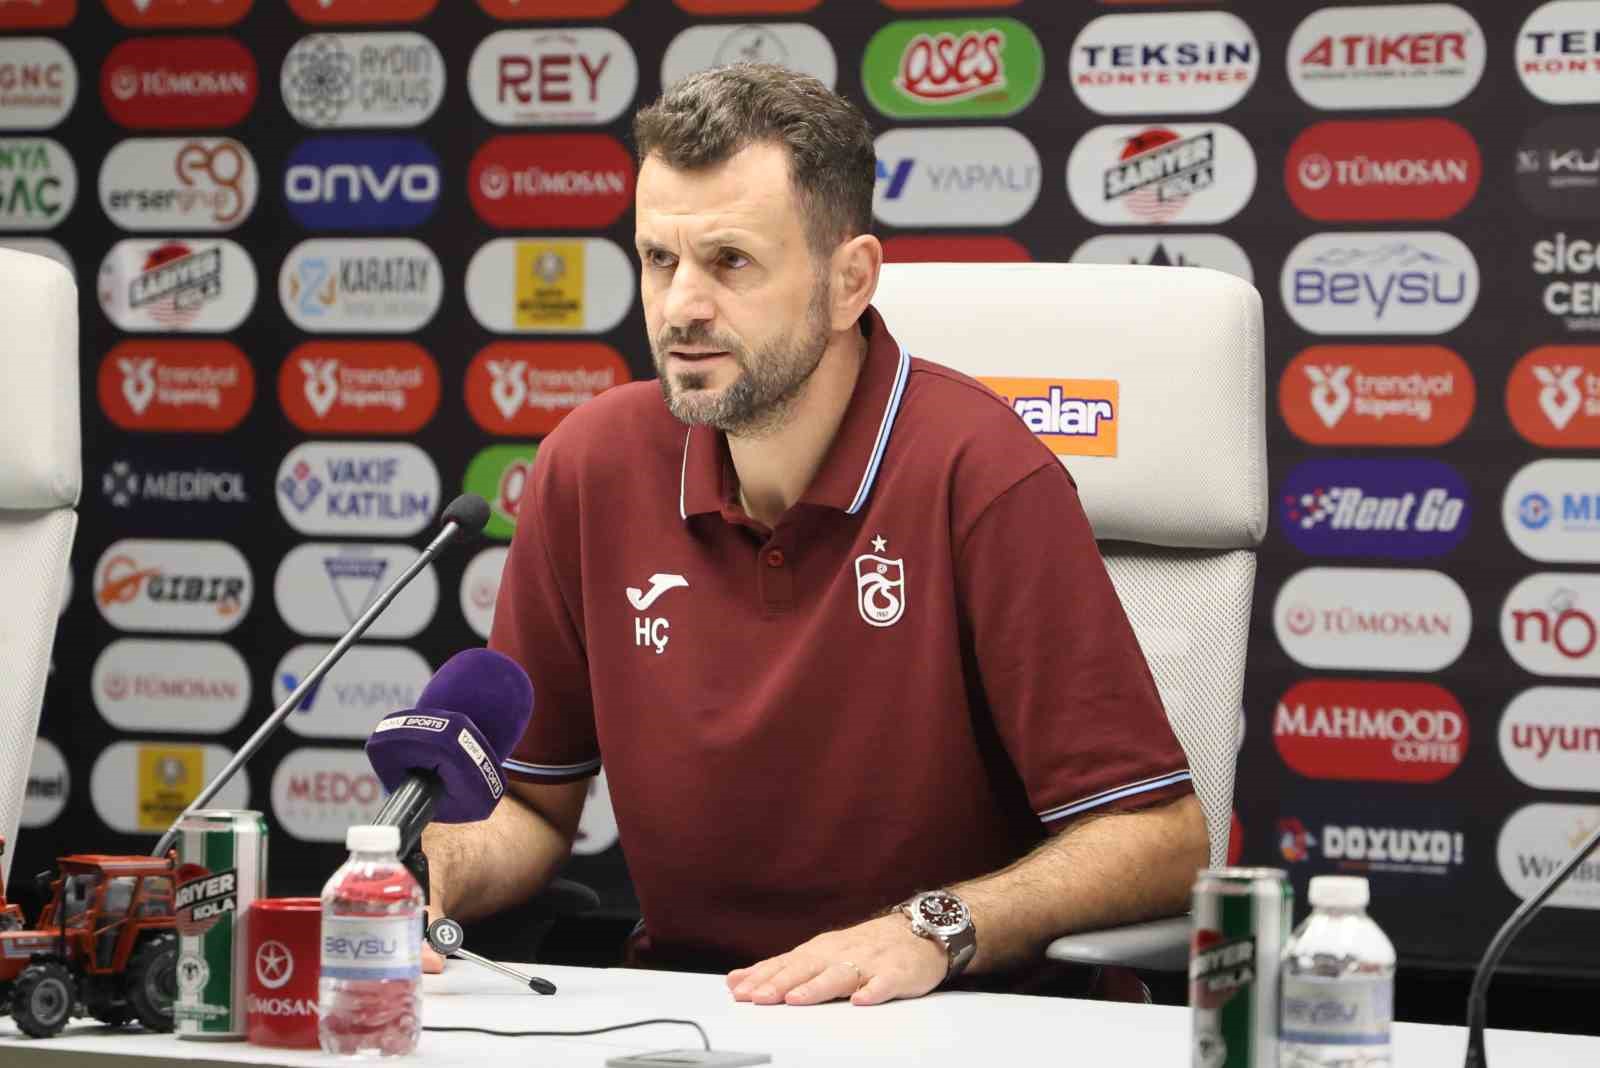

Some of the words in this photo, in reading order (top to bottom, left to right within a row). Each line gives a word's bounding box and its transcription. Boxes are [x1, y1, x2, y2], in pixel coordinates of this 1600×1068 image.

[1526, 31, 1600, 54] TE
[142, 68, 246, 95] TÜMOSAN
[498, 54, 610, 103] REY
[512, 166, 626, 194] TÜMOSAN
[1336, 155, 1468, 186] TÜMOSAN
[339, 258, 428, 292] KARATAY
[1294, 269, 1466, 320] Beysu
[340, 366, 423, 390] trendyol
[528, 368, 615, 389] trendyol
[1355, 372, 1454, 398] trendyol
[326, 459, 397, 483] VAKIF
[327, 492, 429, 520] KATILIM
[1331, 487, 1414, 531] Rent
[1415, 488, 1465, 532] Go
[634, 616, 670, 654] HÇ
[1321, 607, 1451, 635] TÜMOSAN
[132, 674, 240, 699] TÜMOSAN
[405, 717, 444, 729] SPORTS
[1274, 702, 1462, 741] MAHMOOD
[1391, 741, 1461, 764] COFFEE
[288, 771, 380, 806] MEDO
[482, 761, 502, 794] SPORTS
